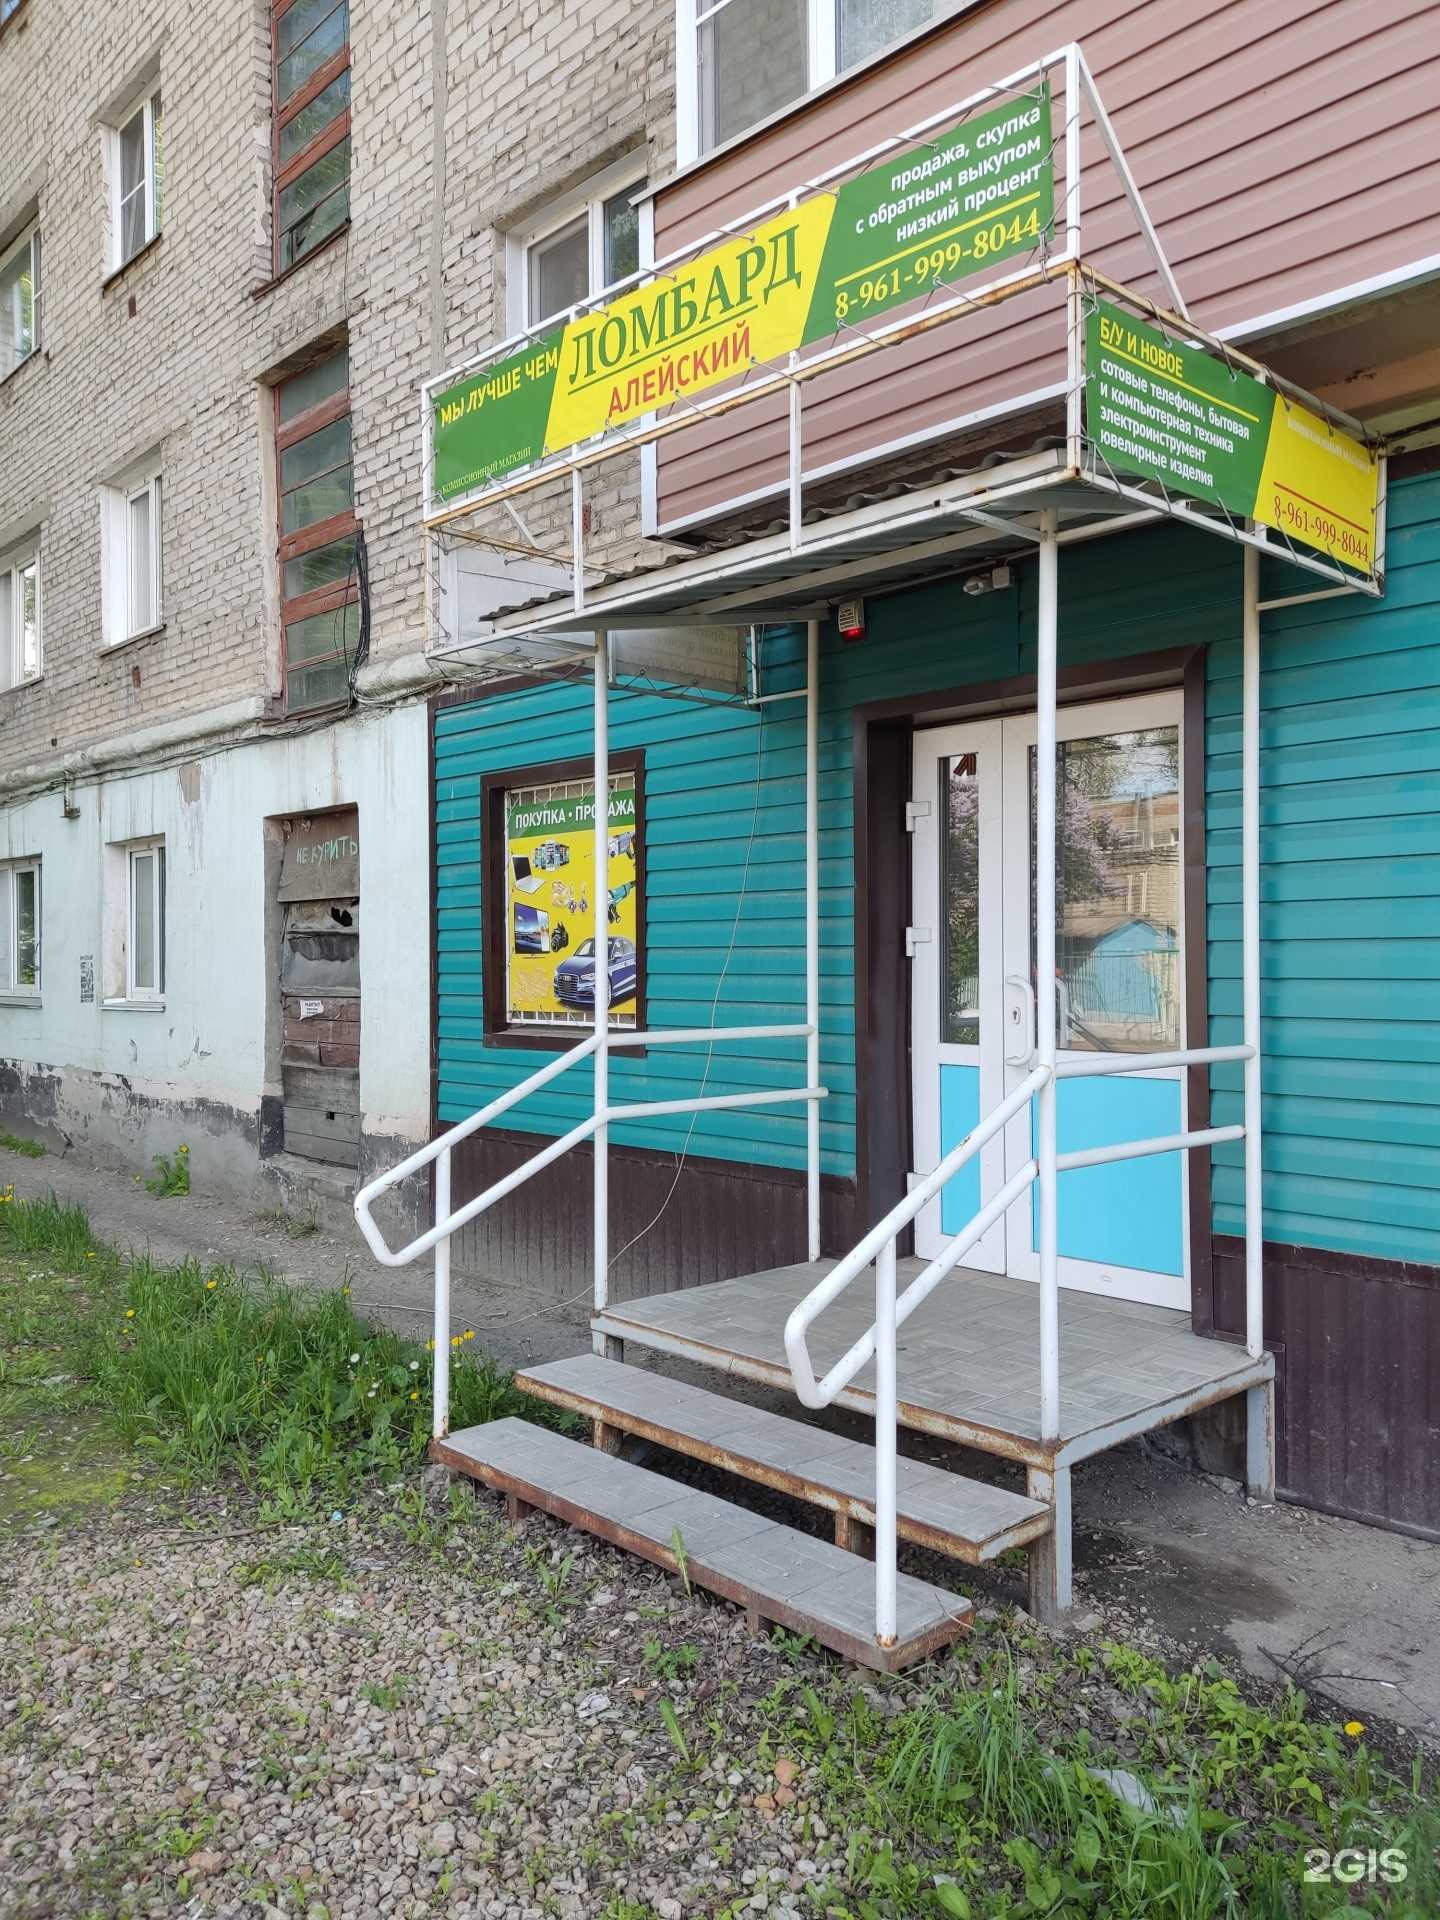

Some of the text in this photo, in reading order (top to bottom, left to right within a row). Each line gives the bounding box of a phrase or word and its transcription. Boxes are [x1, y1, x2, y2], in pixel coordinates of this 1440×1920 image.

[856, 136, 1041, 234] с обратным выкупом
[891, 107, 1040, 191] продажа, скупка
[896, 164, 1041, 242] низкий процент
[835, 207, 1041, 319] 8-961-999-8044
[569, 224, 801, 384] ЛОМБАРД
[608, 320, 749, 417] АЛЕЙСКИЙ
[1100, 317, 1184, 378] Б/У И НОВОЕ
[440, 347, 558, 428] МЫ ЛУЧШЕ ЧЕМ
[1100, 358, 1250, 440] сотовые телефоны, бытовая
[1111, 387, 1191, 437] компьютерная
[1193, 424, 1234, 454] техника
[1100, 406, 1206, 463] электроинструмент
[1100, 429, 1213, 487] ювелирные изделия
[1274, 495, 1368, 562] 8-961-999-8044
[515, 798, 635, 829] ПОКУПКА ПРОАЖА
